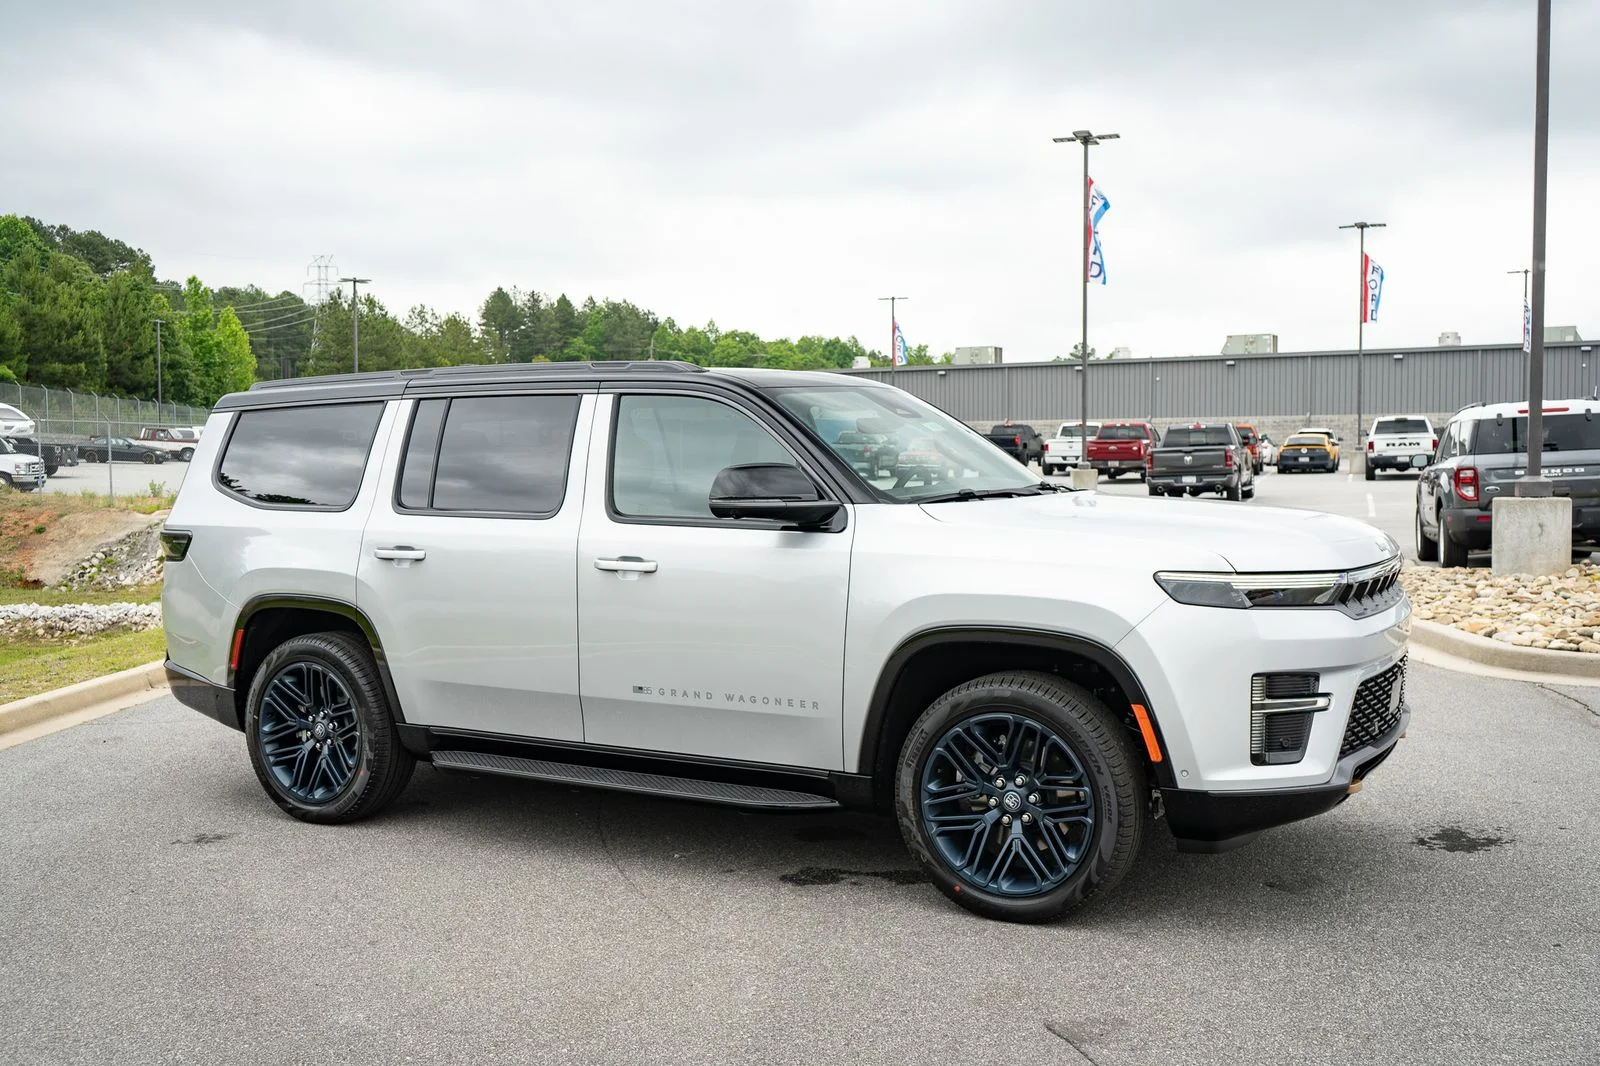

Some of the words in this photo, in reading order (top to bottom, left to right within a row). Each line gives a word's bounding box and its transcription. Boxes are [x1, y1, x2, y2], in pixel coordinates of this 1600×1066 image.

[1514, 467, 1585, 475] BONCO
[658, 688, 713, 700] GRAND
[725, 693, 820, 710] WAGONEER
